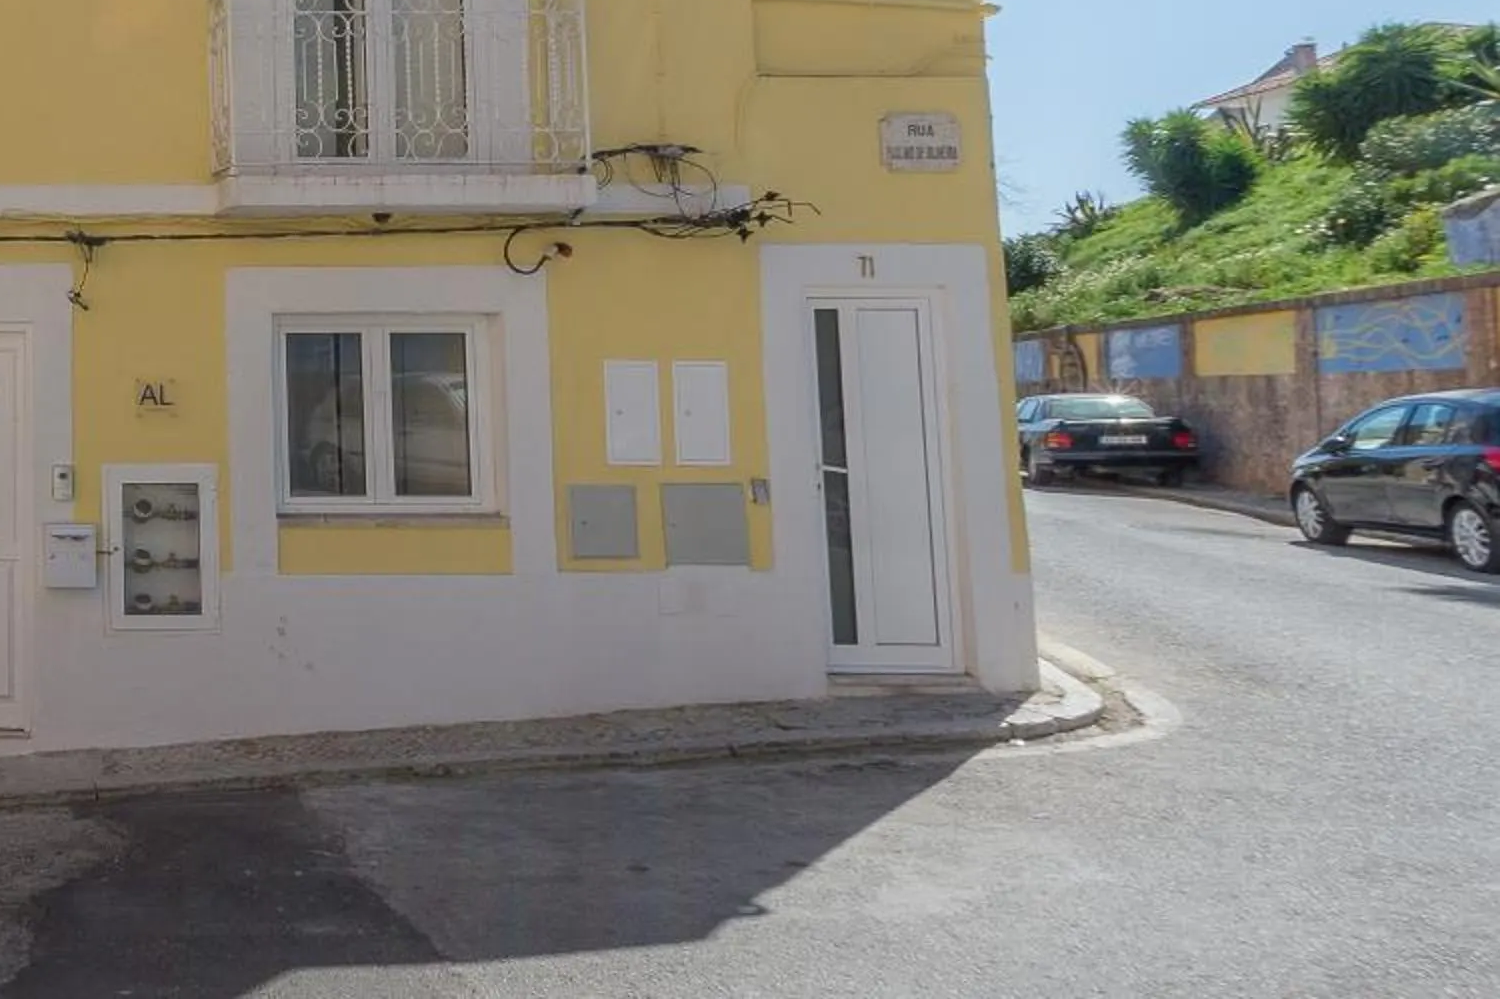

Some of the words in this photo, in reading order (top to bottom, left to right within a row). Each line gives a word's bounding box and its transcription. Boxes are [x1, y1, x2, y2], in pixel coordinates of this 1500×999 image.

[907, 124, 934, 137] RUA
[857, 256, 875, 279] 71
[139, 384, 175, 406] AL
